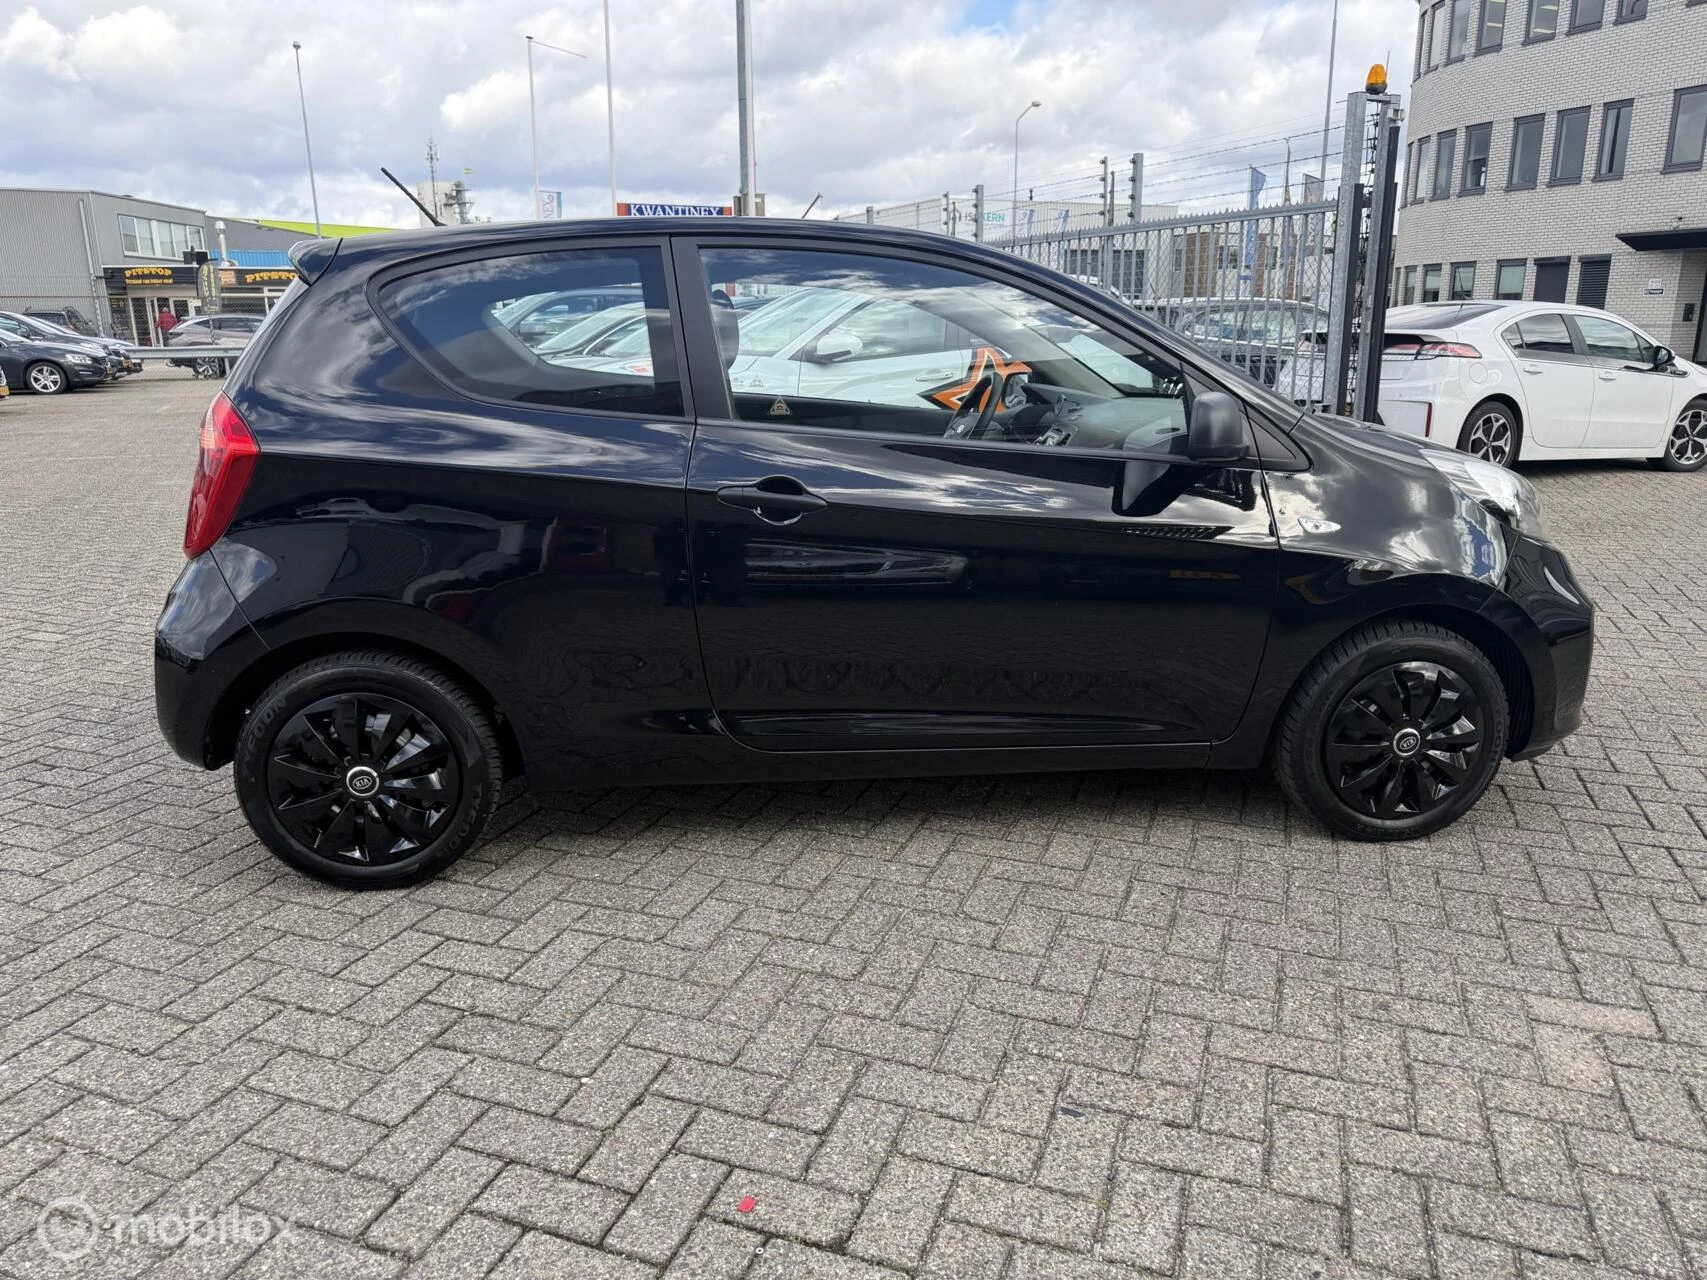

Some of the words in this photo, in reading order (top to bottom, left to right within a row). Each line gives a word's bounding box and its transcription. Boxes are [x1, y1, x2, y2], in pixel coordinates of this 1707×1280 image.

[124, 267, 172, 277] PITSTOP
[245, 271, 298, 283] PITSTO
[1401, 737, 1416, 749] KIA
[354, 777, 371, 788] KIA
